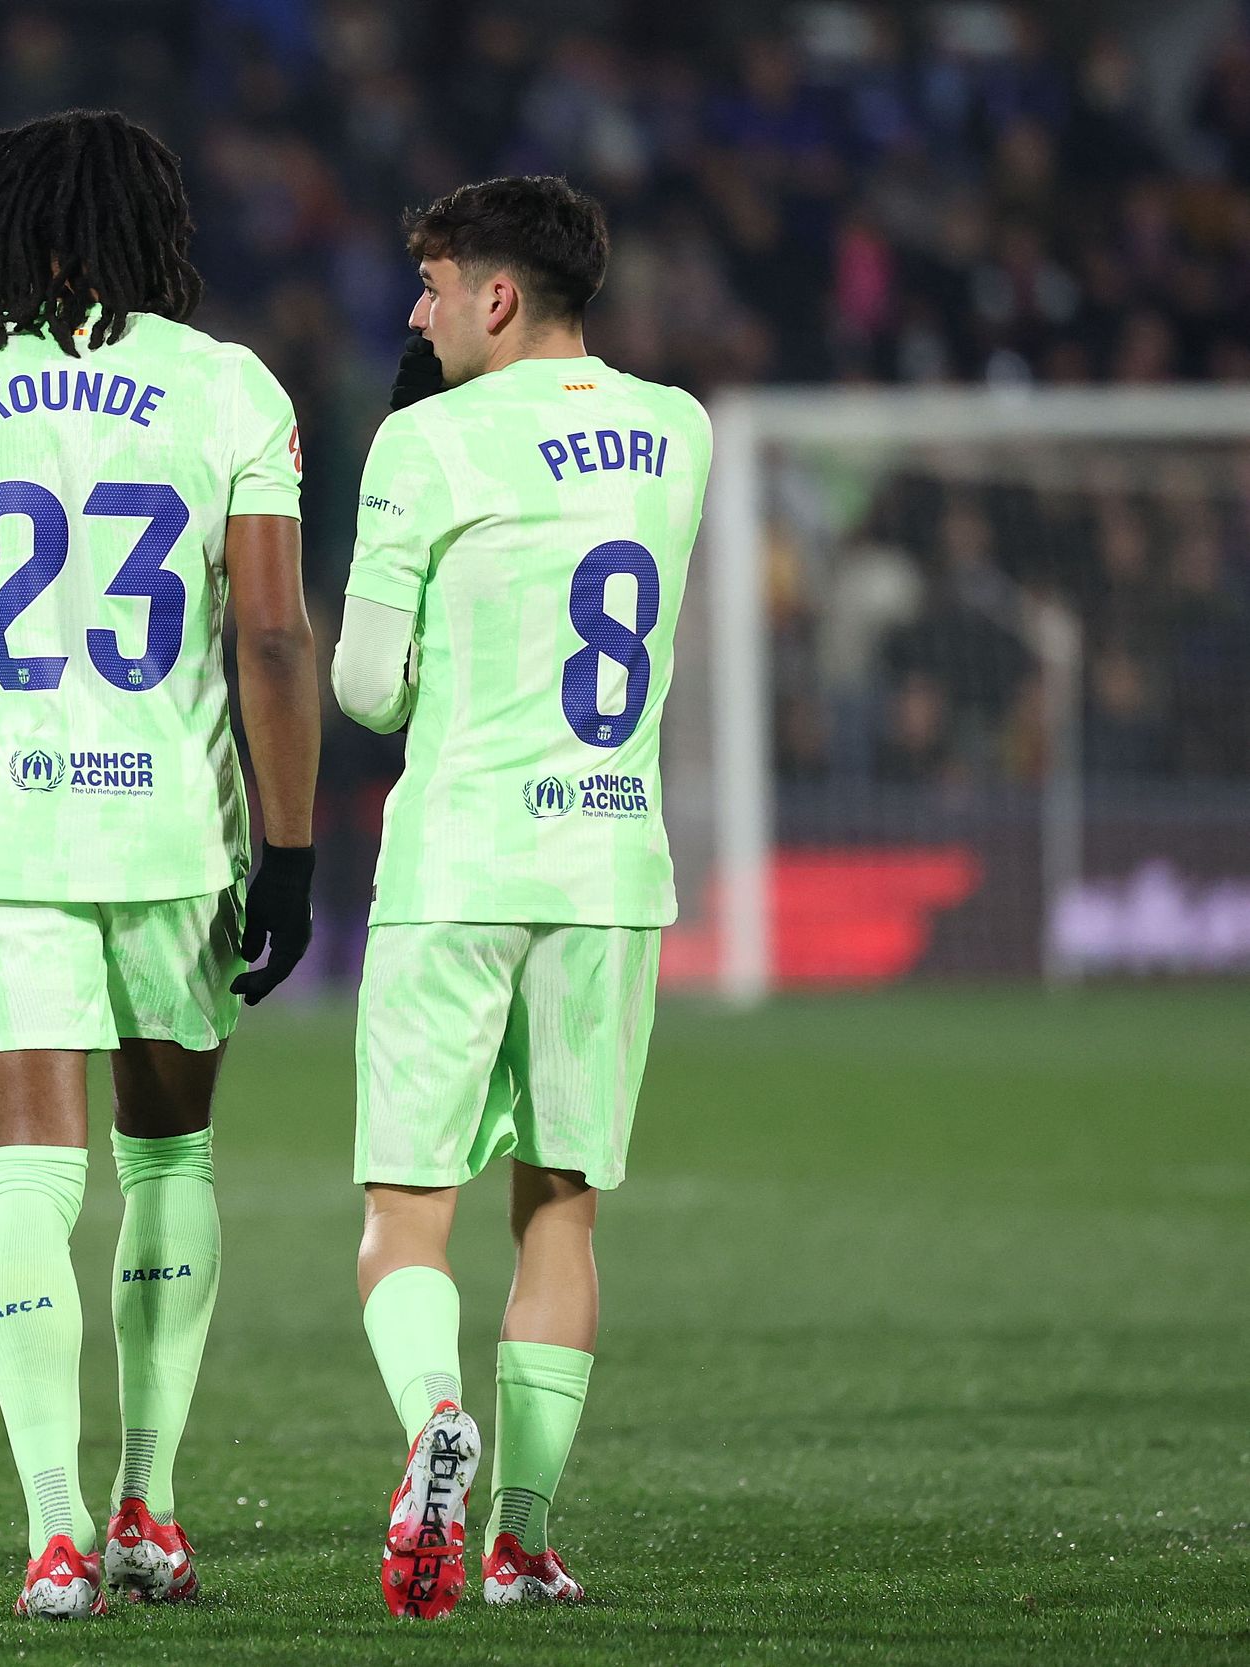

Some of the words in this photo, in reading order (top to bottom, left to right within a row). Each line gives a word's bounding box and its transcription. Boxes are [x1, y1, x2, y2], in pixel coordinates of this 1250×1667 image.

[537, 429, 668, 482] PEDRI
[392, 504, 405, 516] tv
[561, 539, 661, 749] 8
[70, 752, 153, 769] UNHCR
[70, 770, 153, 788] ACNUR
[579, 774, 645, 794] UNHCR
[97, 788, 126, 796] Refugee
[127, 789, 153, 797] Agency
[581, 792, 648, 811] ACNUR
[604, 811, 628, 819] Refugee
